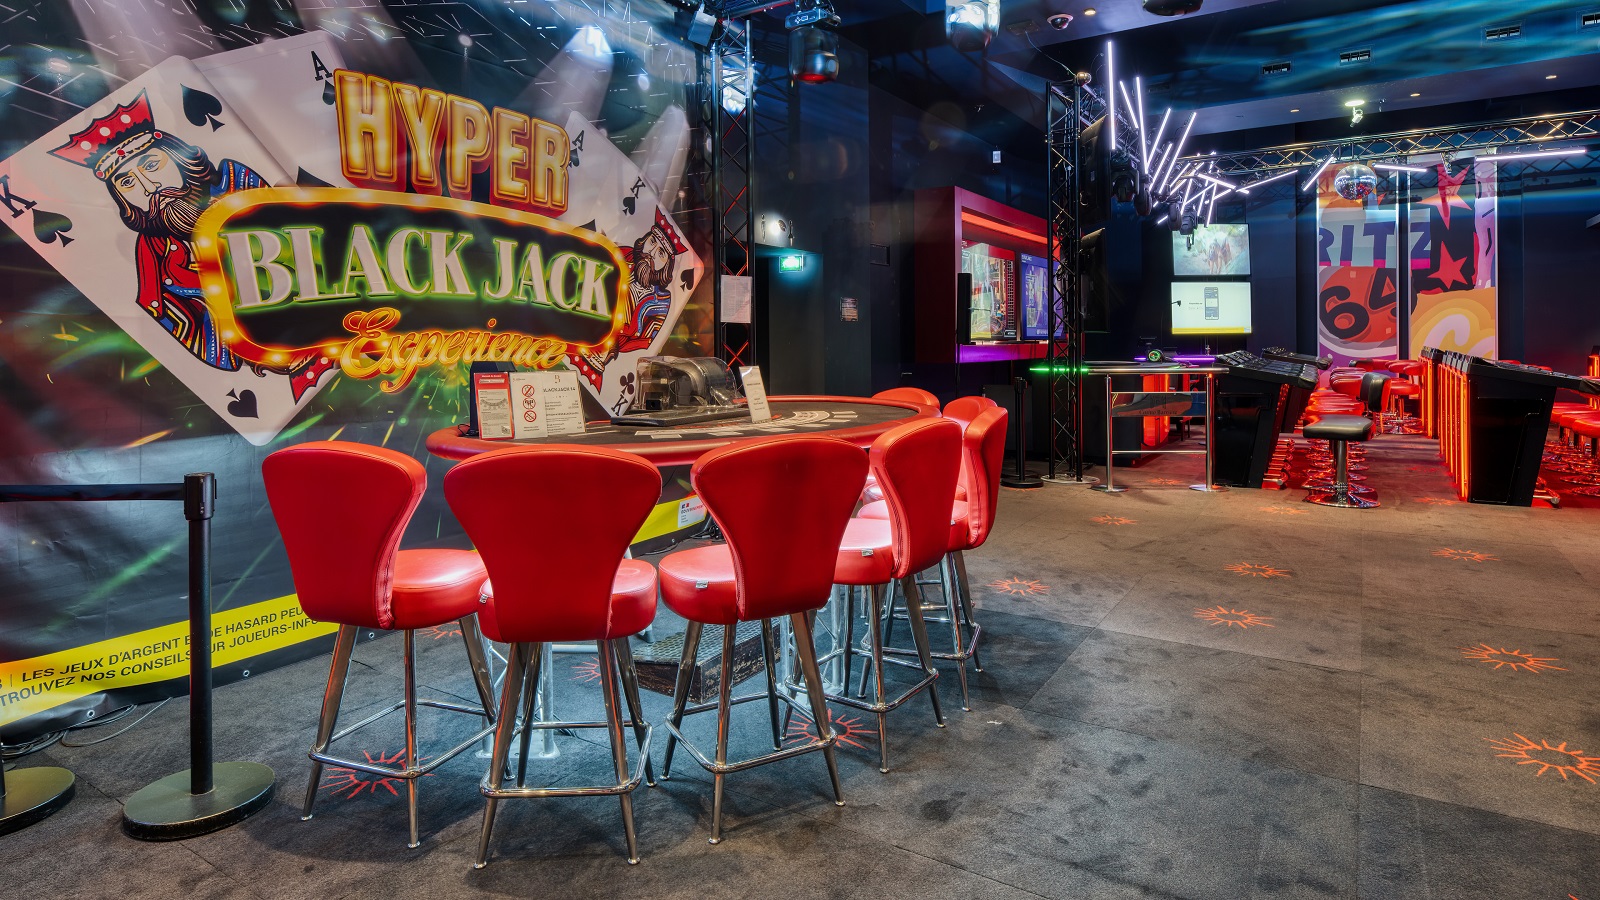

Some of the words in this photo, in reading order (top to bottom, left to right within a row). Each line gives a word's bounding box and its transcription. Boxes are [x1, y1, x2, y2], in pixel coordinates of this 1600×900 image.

[310, 50, 333, 81] A
[333, 68, 571, 218] HYPER
[571, 129, 585, 152] A
[629, 175, 646, 200] K
[219, 224, 475, 310] BLACK
[483, 237, 614, 319] JACK
[340, 307, 568, 394] Experience
[0, 676, 76, 707] TROUVEZ
[80, 669, 116, 683] NOS
[120, 650, 191, 677] CONSEILS
[210, 641, 226, 654] UR
[22, 667, 55, 682] LES
[59, 657, 104, 675] JEUX
[108, 637, 181, 666] D'ARGENT
[225, 612, 277, 635] HASARD
